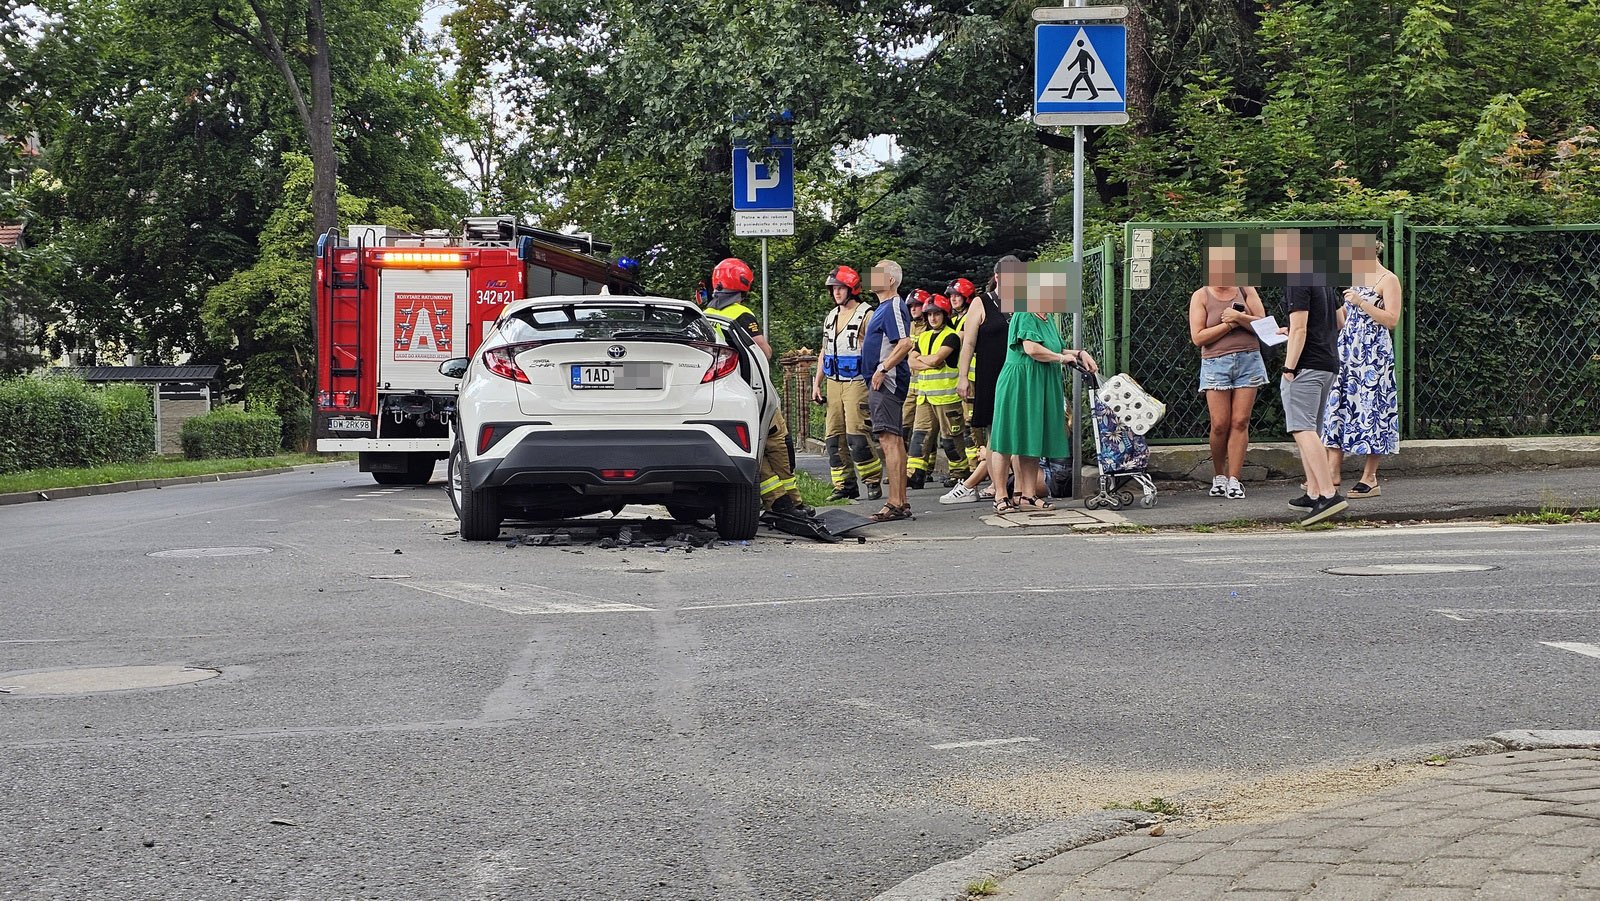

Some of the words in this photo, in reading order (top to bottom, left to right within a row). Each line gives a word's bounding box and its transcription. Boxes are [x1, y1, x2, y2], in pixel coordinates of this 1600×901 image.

[747, 154, 780, 203] P
[1134, 233, 1141, 242] Z
[1132, 263, 1139, 273] Z
[585, 368, 610, 382] 1AD
